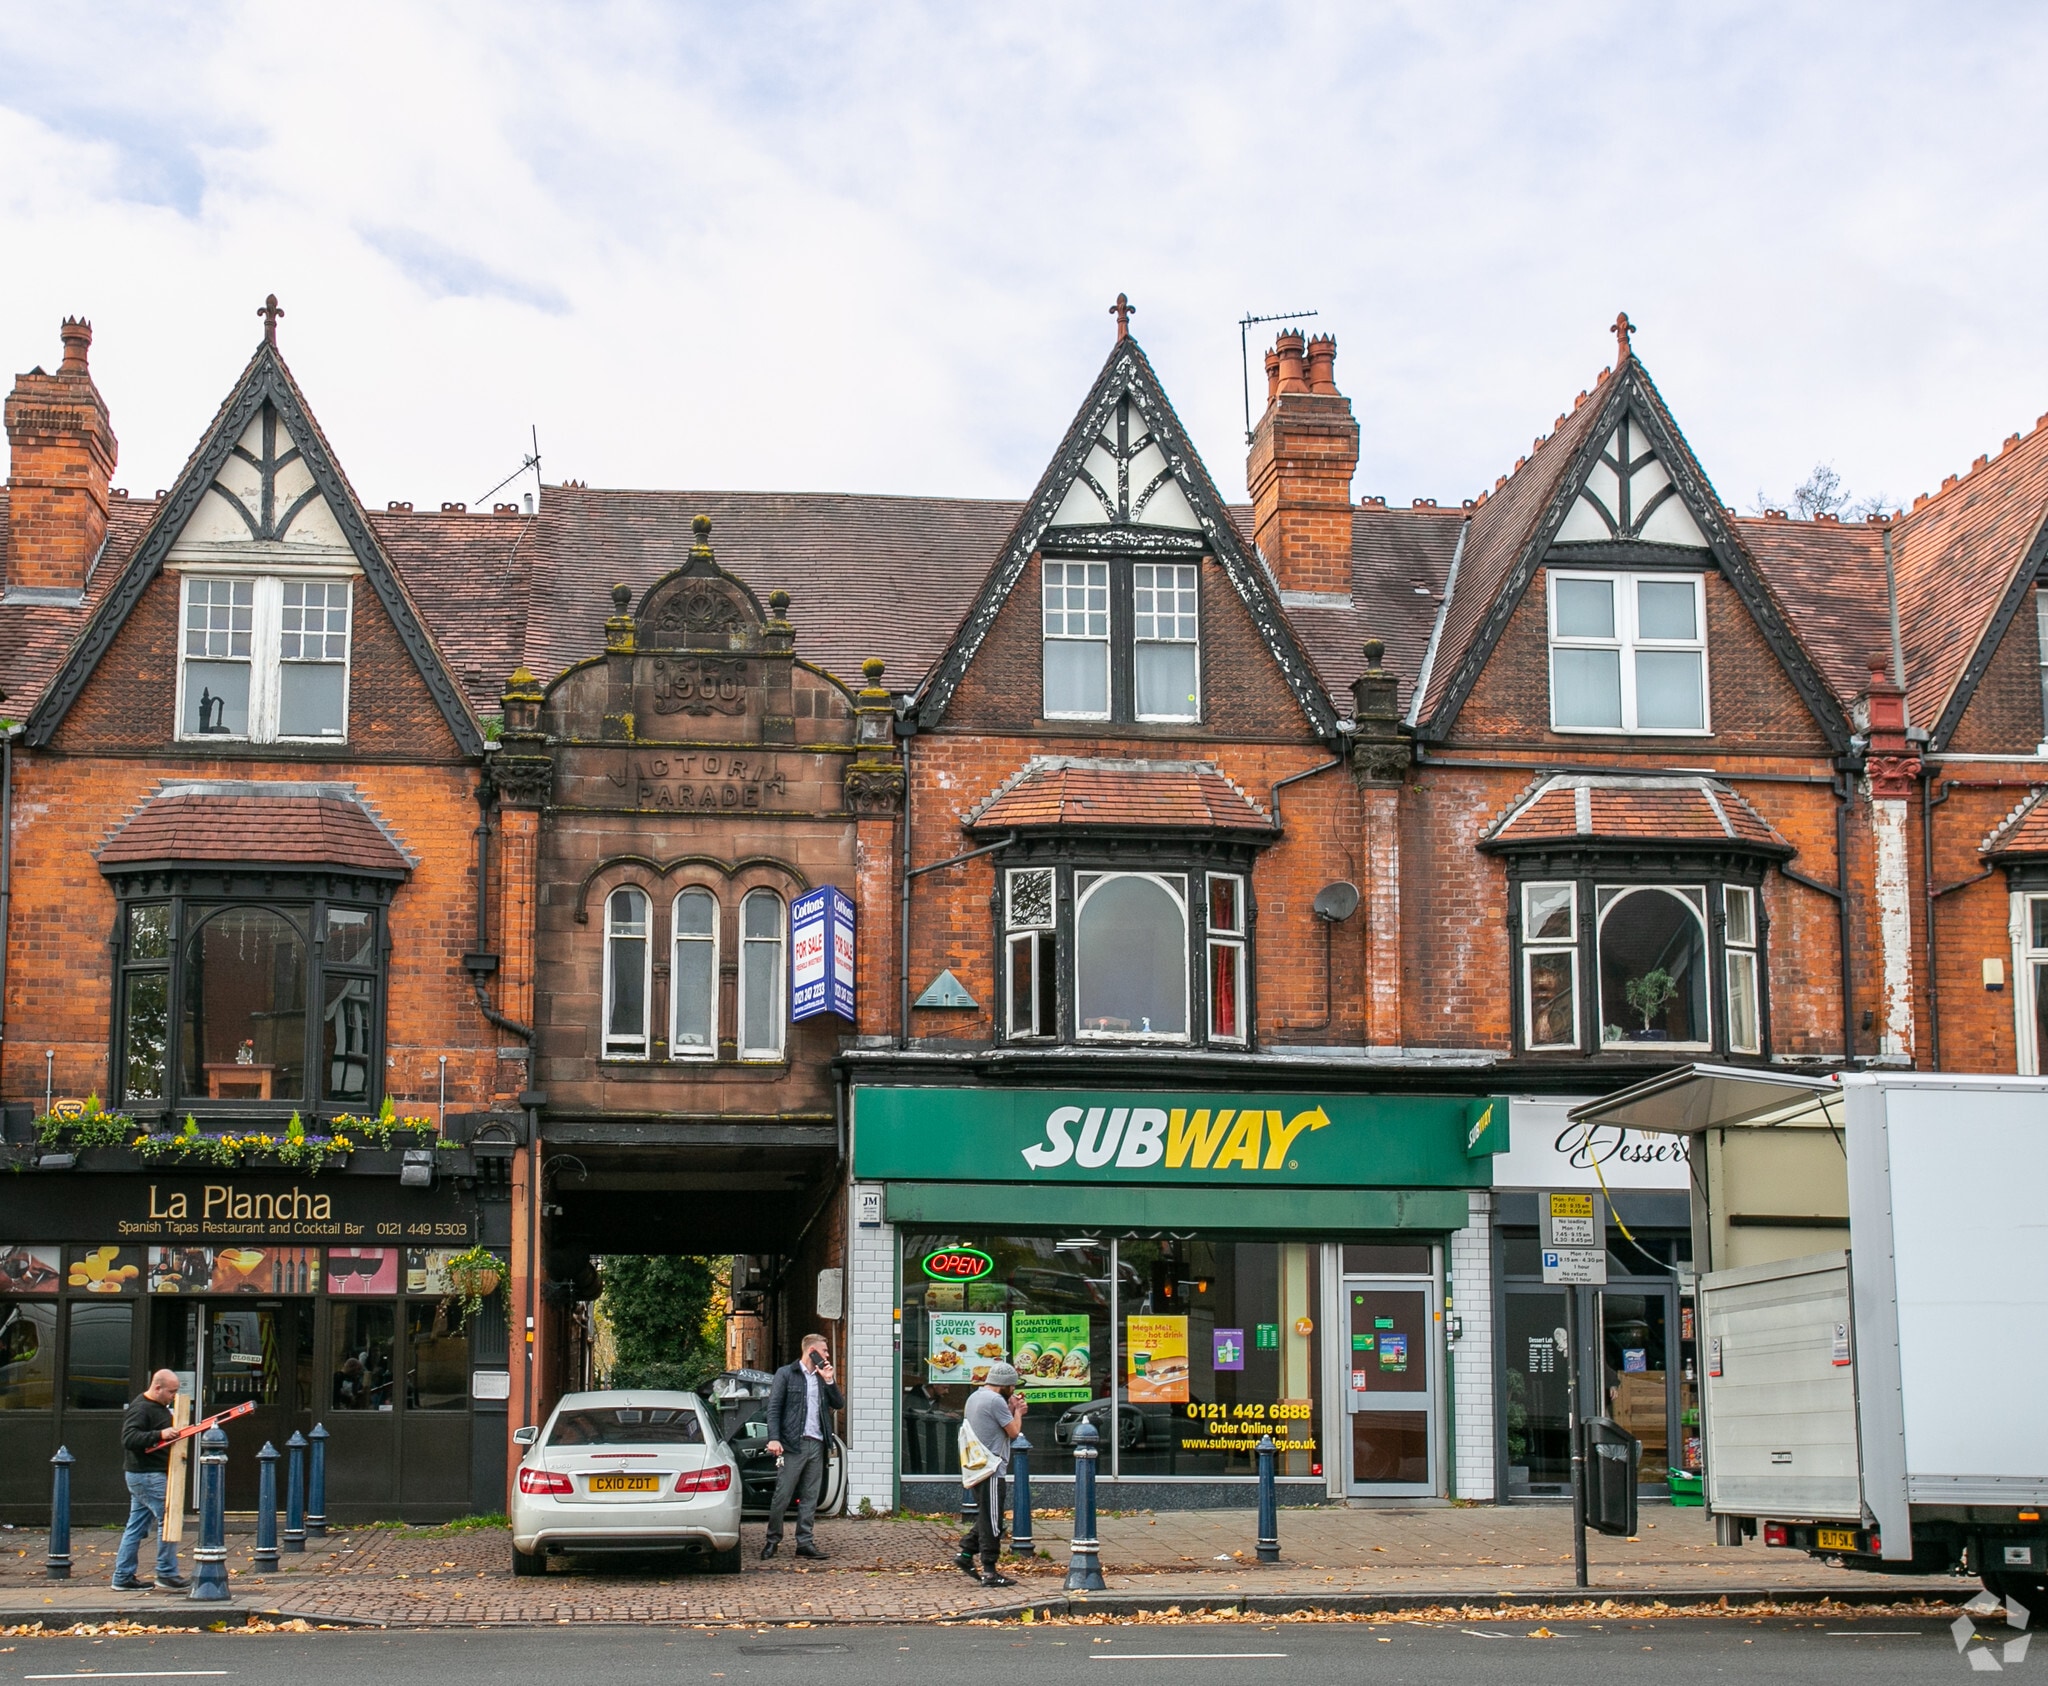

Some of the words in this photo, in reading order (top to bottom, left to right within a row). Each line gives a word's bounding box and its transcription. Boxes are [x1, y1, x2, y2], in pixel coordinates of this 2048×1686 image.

[662, 674, 738, 700] 1900
[607, 755, 786, 795] VICTORIA
[638, 786, 759, 807] PARADE
[794, 896, 824, 920] Cottons
[796, 940, 806, 960] FOR
[808, 934, 822, 954] SALE
[1468, 1104, 1493, 1149] SUBWAY
[1021, 1104, 1331, 1171] SUBWAY
[150, 1185, 187, 1219] La
[203, 1185, 331, 1220] Plancha
[863, 1196, 877, 1206] JM
[118, 1221, 161, 1235] Spanish
[166, 1221, 199, 1236] Tapas
[203, 1221, 265, 1234] Restaurant
[269, 1222, 290, 1234] and
[294, 1222, 340, 1234] Cocktail
[345, 1223, 364, 1234] Bar
[377, 1223, 401, 1235] 0121
[407, 1224, 431, 1235] 449
[435, 1224, 467, 1236] 5303
[931, 1254, 984, 1275] OPEN
[1547, 1255, 1556, 1266] P
[979, 1326, 1002, 1338] 99p
[1145, 1340, 1158, 1348] £3
[1187, 1403, 1227, 1418] 0121
[1233, 1404, 1264, 1419] 442
[1270, 1404, 1311, 1419] 6888
[1210, 1422, 1238, 1434] Order
[1241, 1422, 1273, 1434] Online
[1275, 1425, 1288, 1434] on
[597, 1478, 624, 1489] CX10
[628, 1478, 651, 1489] ZDT
